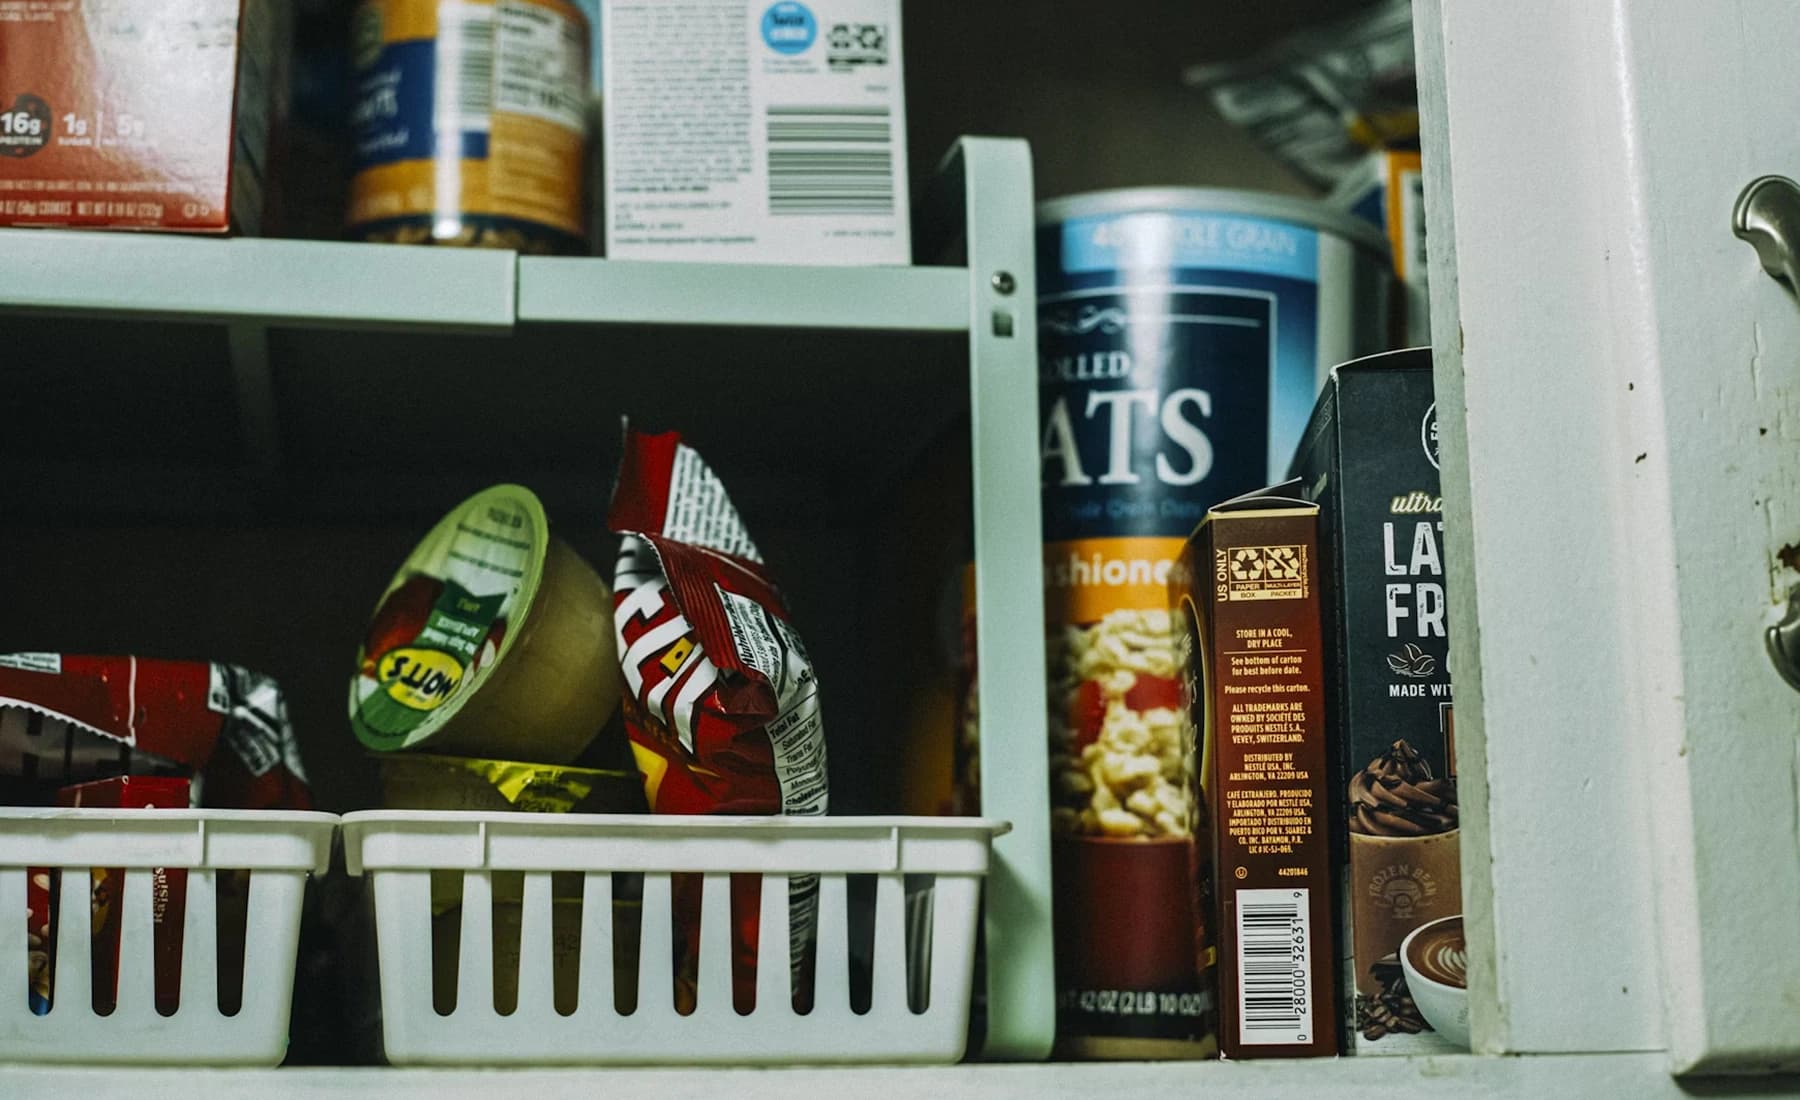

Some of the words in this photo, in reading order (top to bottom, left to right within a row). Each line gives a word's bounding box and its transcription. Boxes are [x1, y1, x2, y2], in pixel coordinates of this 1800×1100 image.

[1, 112, 41, 135] 16g
[63, 112, 87, 136] 1g
[1041, 388, 1213, 486] ATS
[1384, 522, 1445, 576] LA
[1216, 549, 1228, 582] ONLY
[1217, 583, 1229, 602] US
[1236, 583, 1260, 591] PAPER
[1270, 590, 1298, 598] PACKET
[1236, 629, 1257, 638] STORE
[1258, 629, 1266, 638] IN
[1267, 629, 1272, 637] A
[1273, 628, 1293, 638] COOL,
[1247, 640, 1260, 648] DRY
[1262, 639, 1283, 648] PLACE
[1231, 656, 1244, 666] See
[1245, 656, 1270, 666] bottom
[1271, 655, 1279, 665] of
[1280, 655, 1302, 664] carton
[1232, 667, 1242, 676] for
[1244, 666, 1259, 676] best
[1260, 666, 1282, 675] before
[1284, 665, 1302, 674] date.
[1225, 685, 1246, 694] Please
[1248, 684, 1272, 695] recycle
[1272, 683, 1285, 693] this
[1286, 683, 1311, 693] carton.
[1389, 684, 1426, 697] MADE
[1232, 703, 1244, 713] ALL
[1245, 703, 1289, 712] TRADEMARKS
[1290, 702, 1303, 711] ARE
[1231, 714, 1255, 723] OWNED
[1256, 713, 1265, 722] BY
[1293, 712, 1306, 721] DES
[769, 720, 789, 738] Total
[786, 711, 800, 728] Fat
[1231, 724, 1264, 733] PRODUITS
[1265, 722, 1288, 732] NESTLÉ
[1232, 735, 1256, 745] VEVEY,
[1256, 733, 1305, 743] SWITZERLAND.
[1244, 753, 1284, 762] DISTRIBUTED
[1284, 752, 1293, 761] BY
[1244, 762, 1266, 771] NESTLÉ
[1267, 772, 1275, 780] VA
[1296, 771, 1309, 779] USA
[1227, 800, 1231, 808] Y
[1266, 799, 1277, 807] POR
[1268, 808, 1275, 816] VA
[1229, 827, 1251, 836] PUERTO
[1266, 827, 1277, 835] POR
[1249, 845, 1257, 854] LIC
[1369, 865, 1409, 897] FROZEN
[1412, 868, 1437, 896] BEAN
[1292, 918, 1305, 961] 32631
[1293, 969, 1306, 1014] 28000
